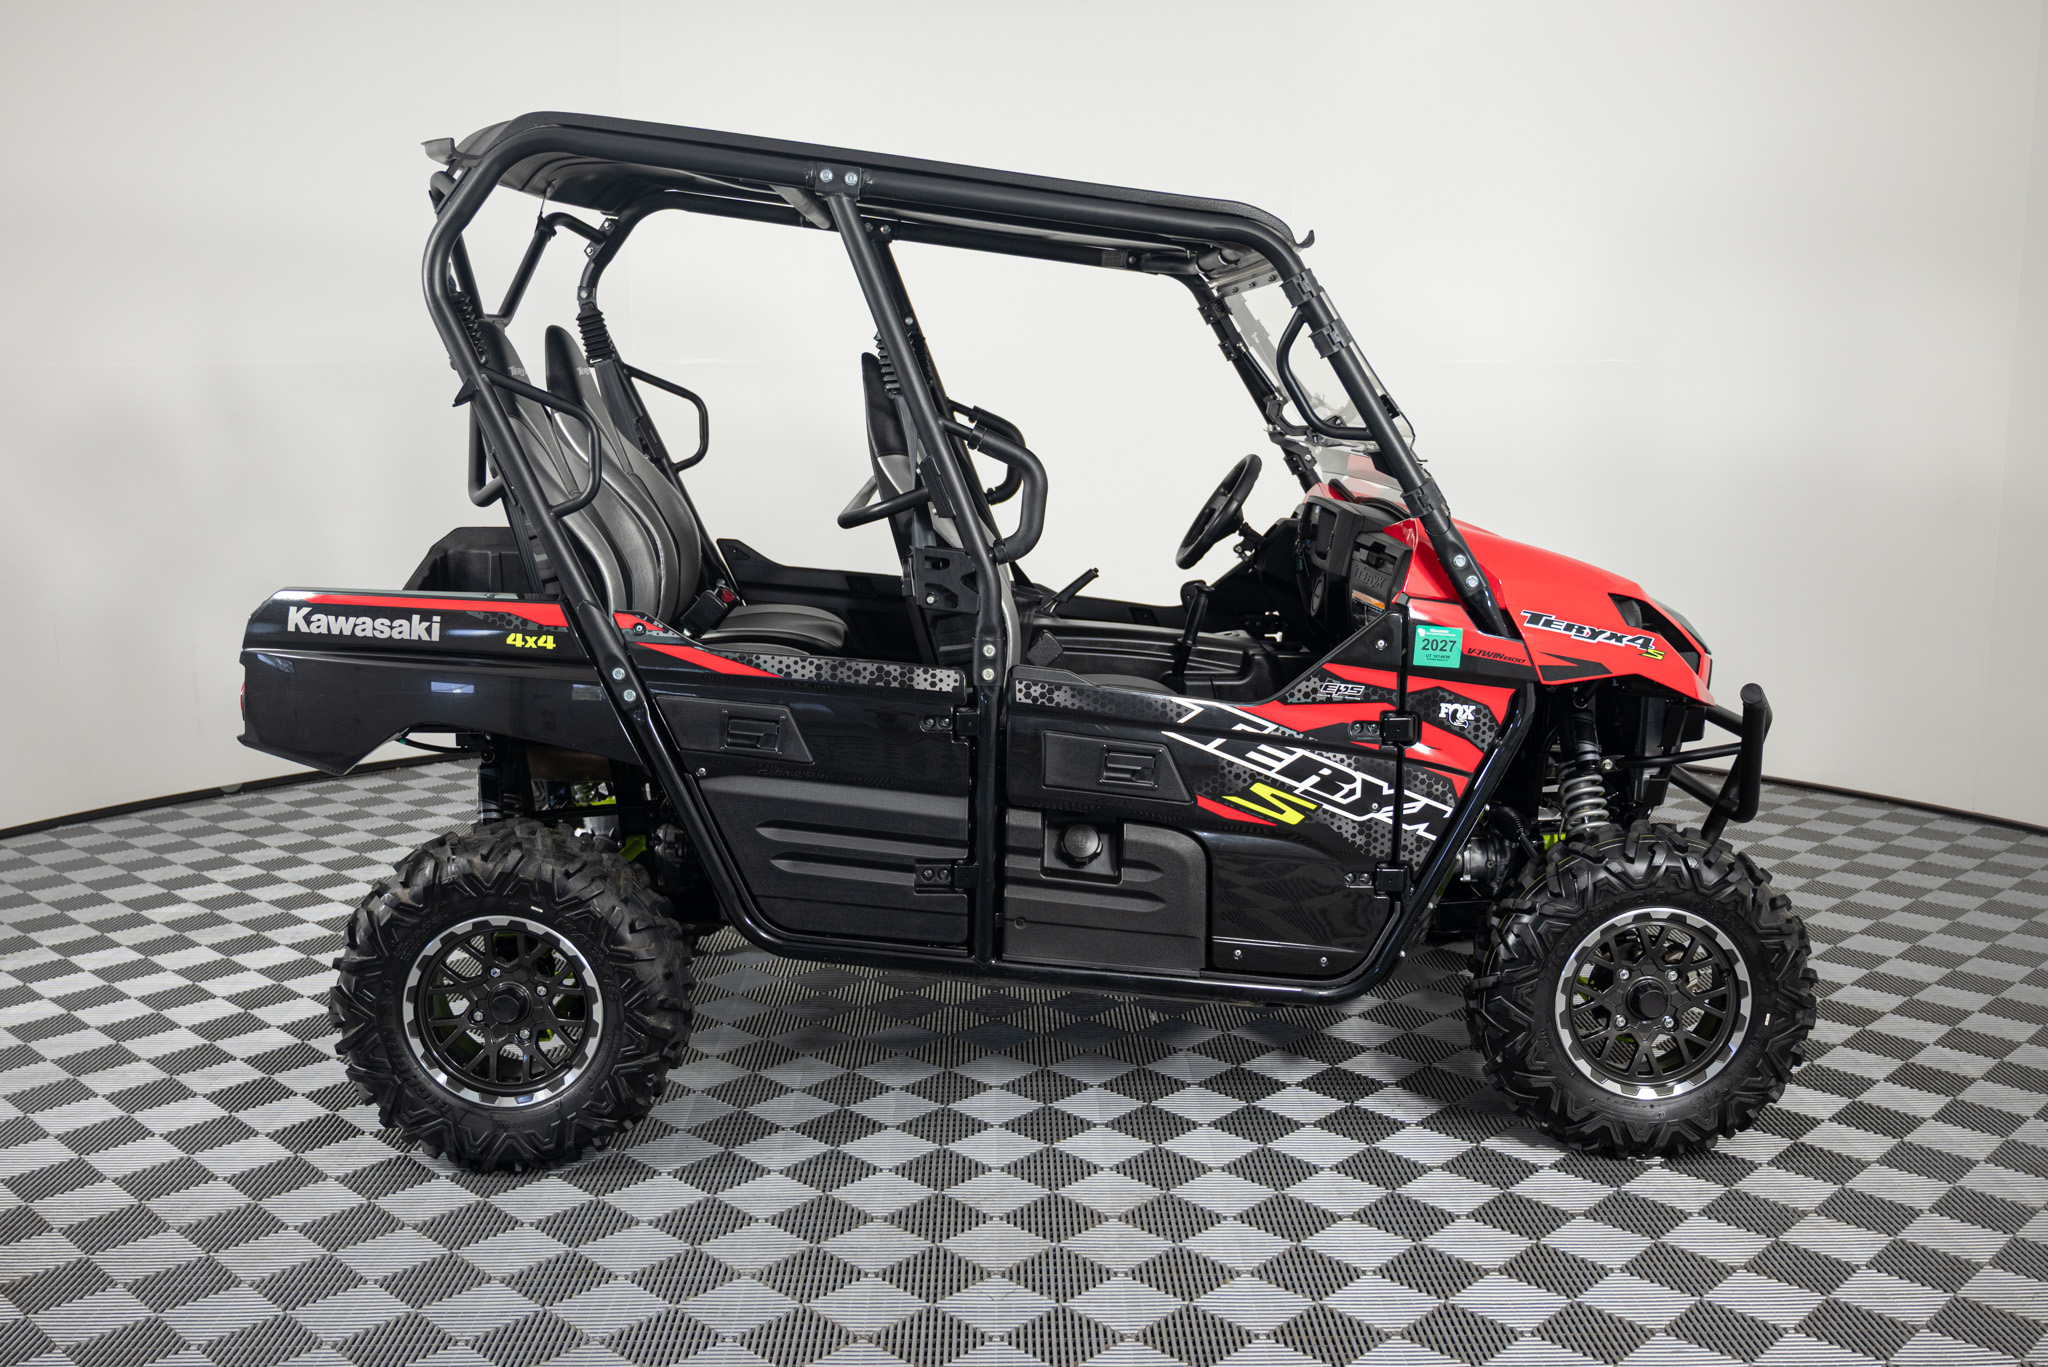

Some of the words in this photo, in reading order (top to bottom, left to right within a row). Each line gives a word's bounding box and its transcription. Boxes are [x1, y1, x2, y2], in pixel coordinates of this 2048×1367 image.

[287, 606, 441, 642] Kawasaki
[506, 633, 557, 650] 4x4
[1421, 638, 1457, 652] 2027
[1320, 682, 1365, 696] EPS
[1438, 702, 1477, 728] FOX
